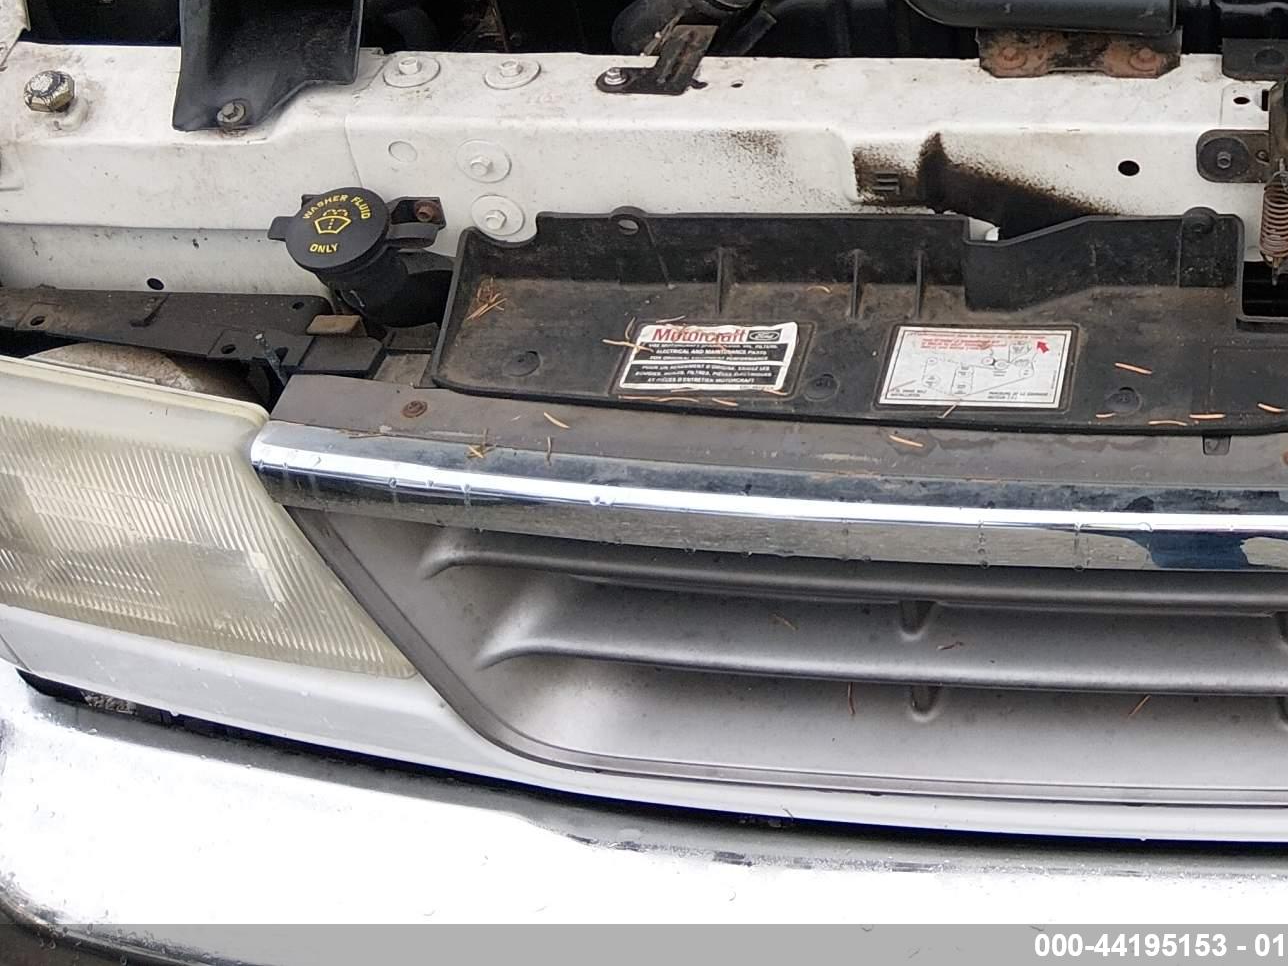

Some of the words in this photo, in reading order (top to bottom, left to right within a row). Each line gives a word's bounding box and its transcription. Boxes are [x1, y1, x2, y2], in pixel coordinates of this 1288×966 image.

[302, 194, 349, 220] WASHER
[350, 196, 372, 220] FLUID
[310, 243, 339, 253] ONLY
[652, 328, 746, 342] Motorcraft
